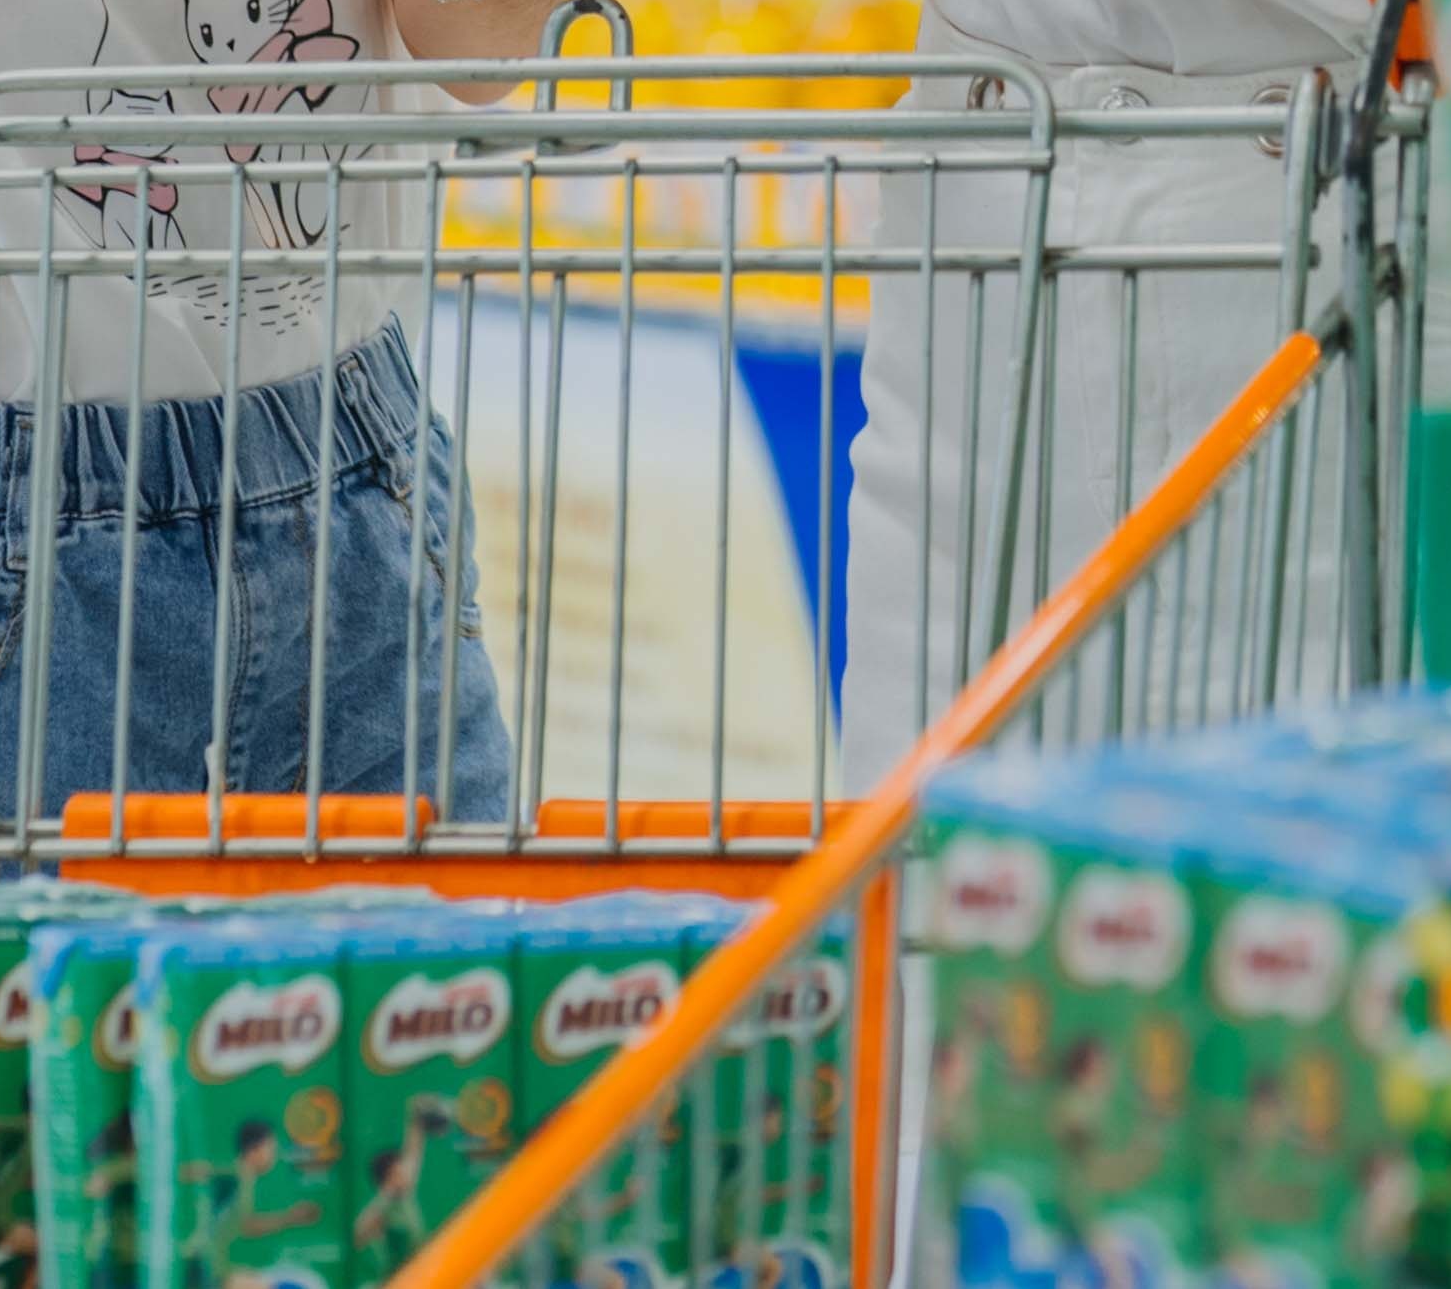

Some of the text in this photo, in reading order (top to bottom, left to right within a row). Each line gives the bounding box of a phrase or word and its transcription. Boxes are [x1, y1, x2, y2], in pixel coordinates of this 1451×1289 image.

[216, 1010, 324, 1055] MILO
[387, 1000, 494, 1045] MILO
[558, 992, 665, 1037] MILO
